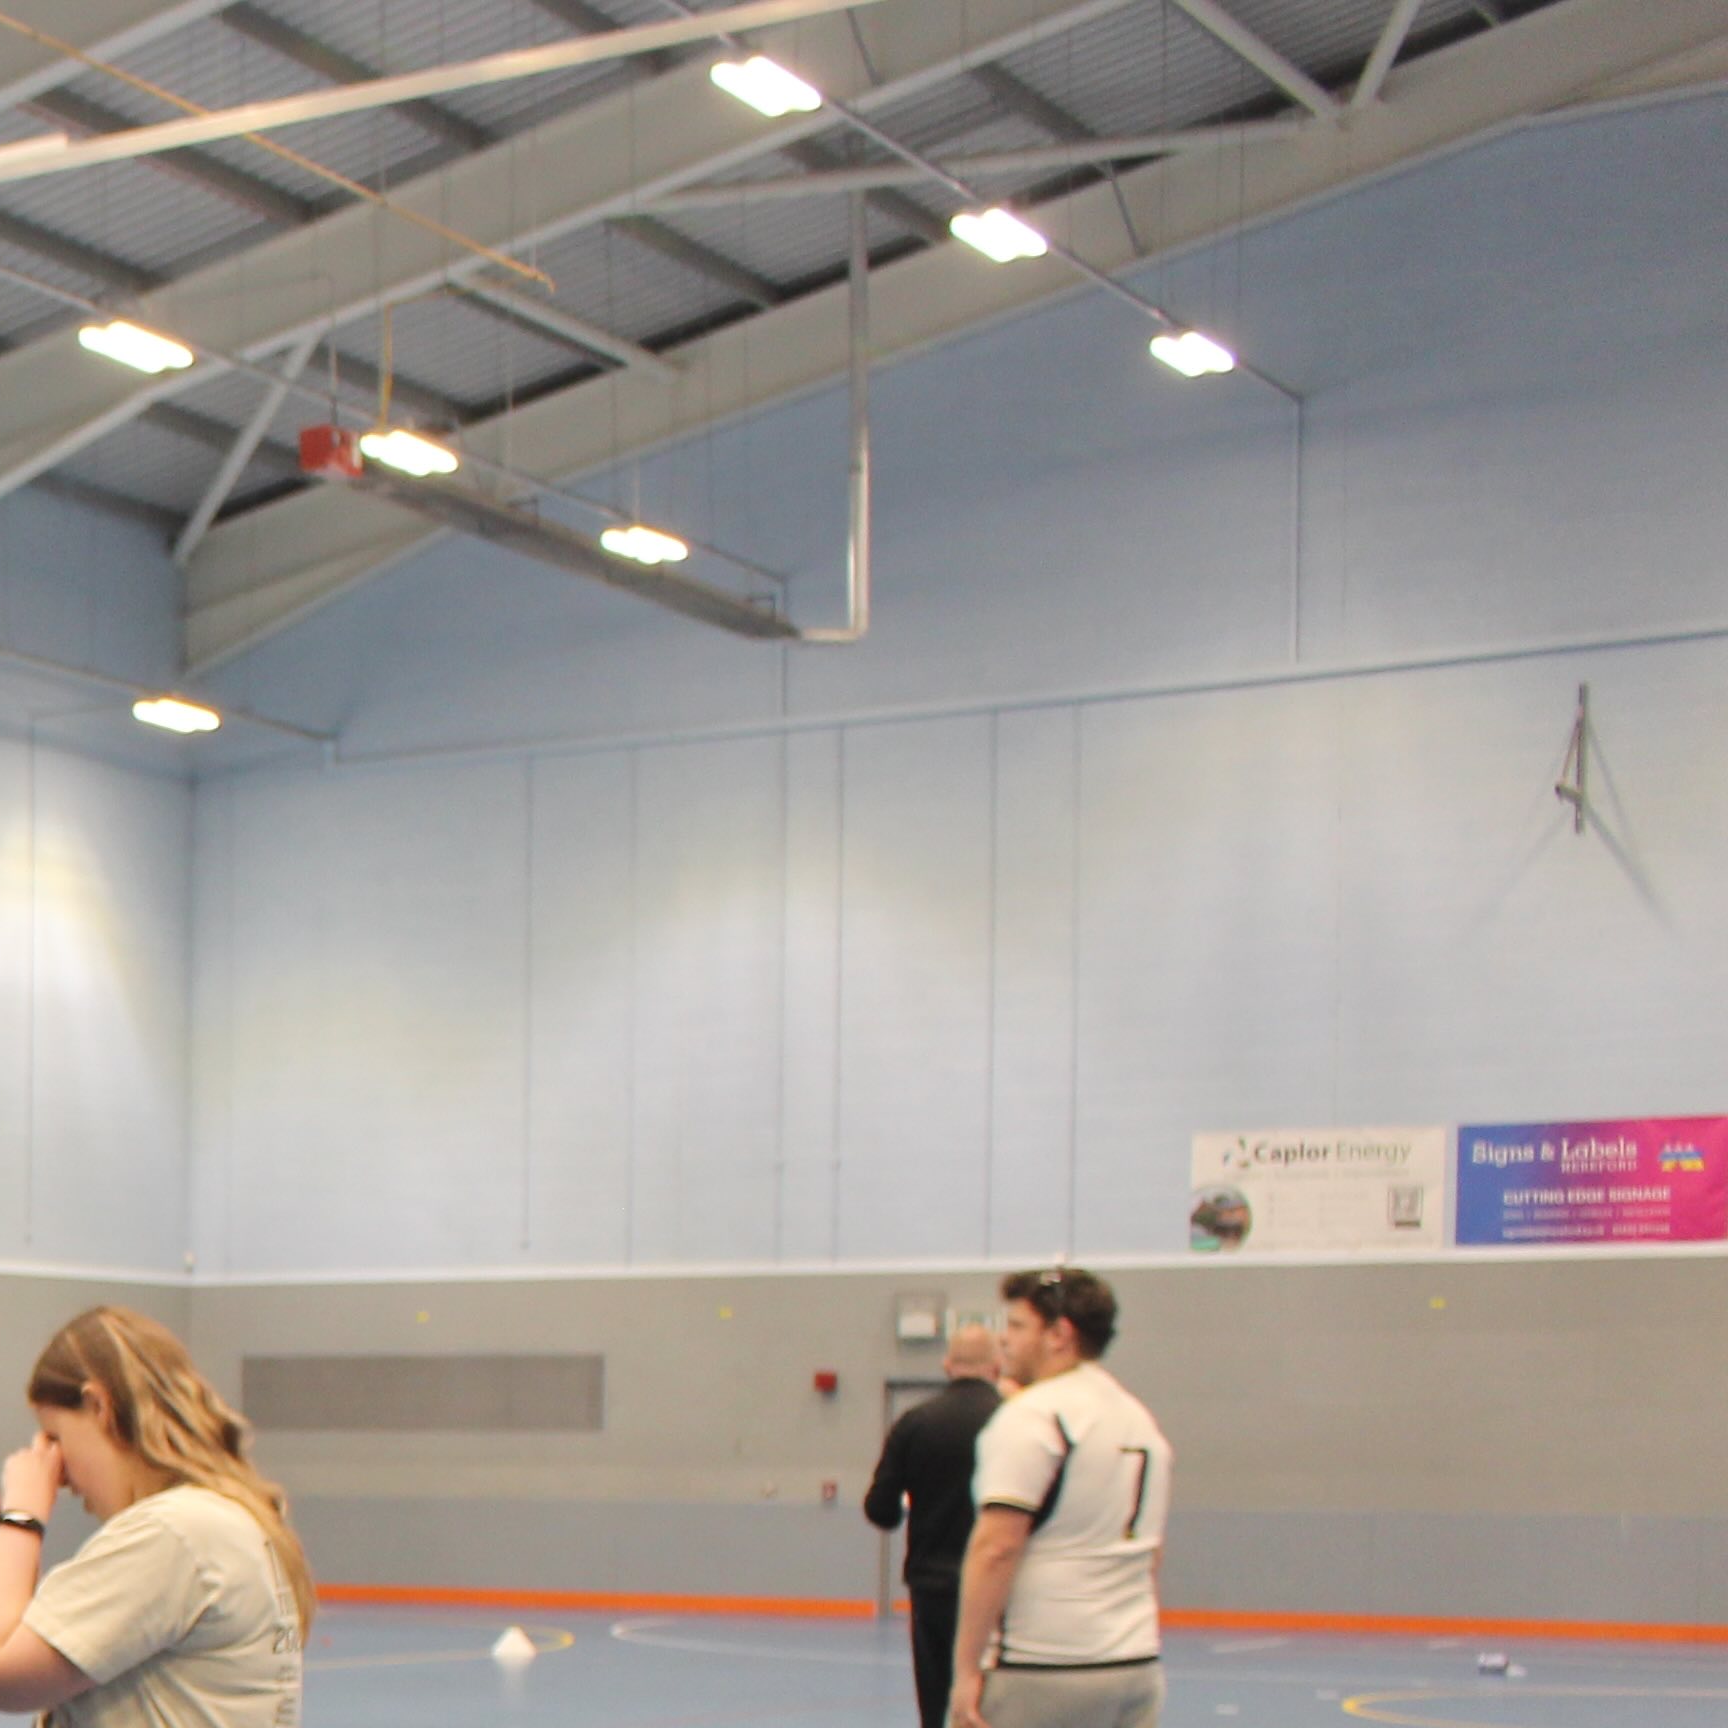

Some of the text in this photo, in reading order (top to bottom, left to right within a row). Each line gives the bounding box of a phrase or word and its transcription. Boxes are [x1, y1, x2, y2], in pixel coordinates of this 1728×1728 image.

[1254, 1140, 1411, 1165] Caplor Energy
[1472, 1137, 1637, 1167] Signs & Labels
[1503, 1186, 1671, 1205] CUTTING EDGE SIGNAGE
[1118, 1447, 1150, 1540] 7
